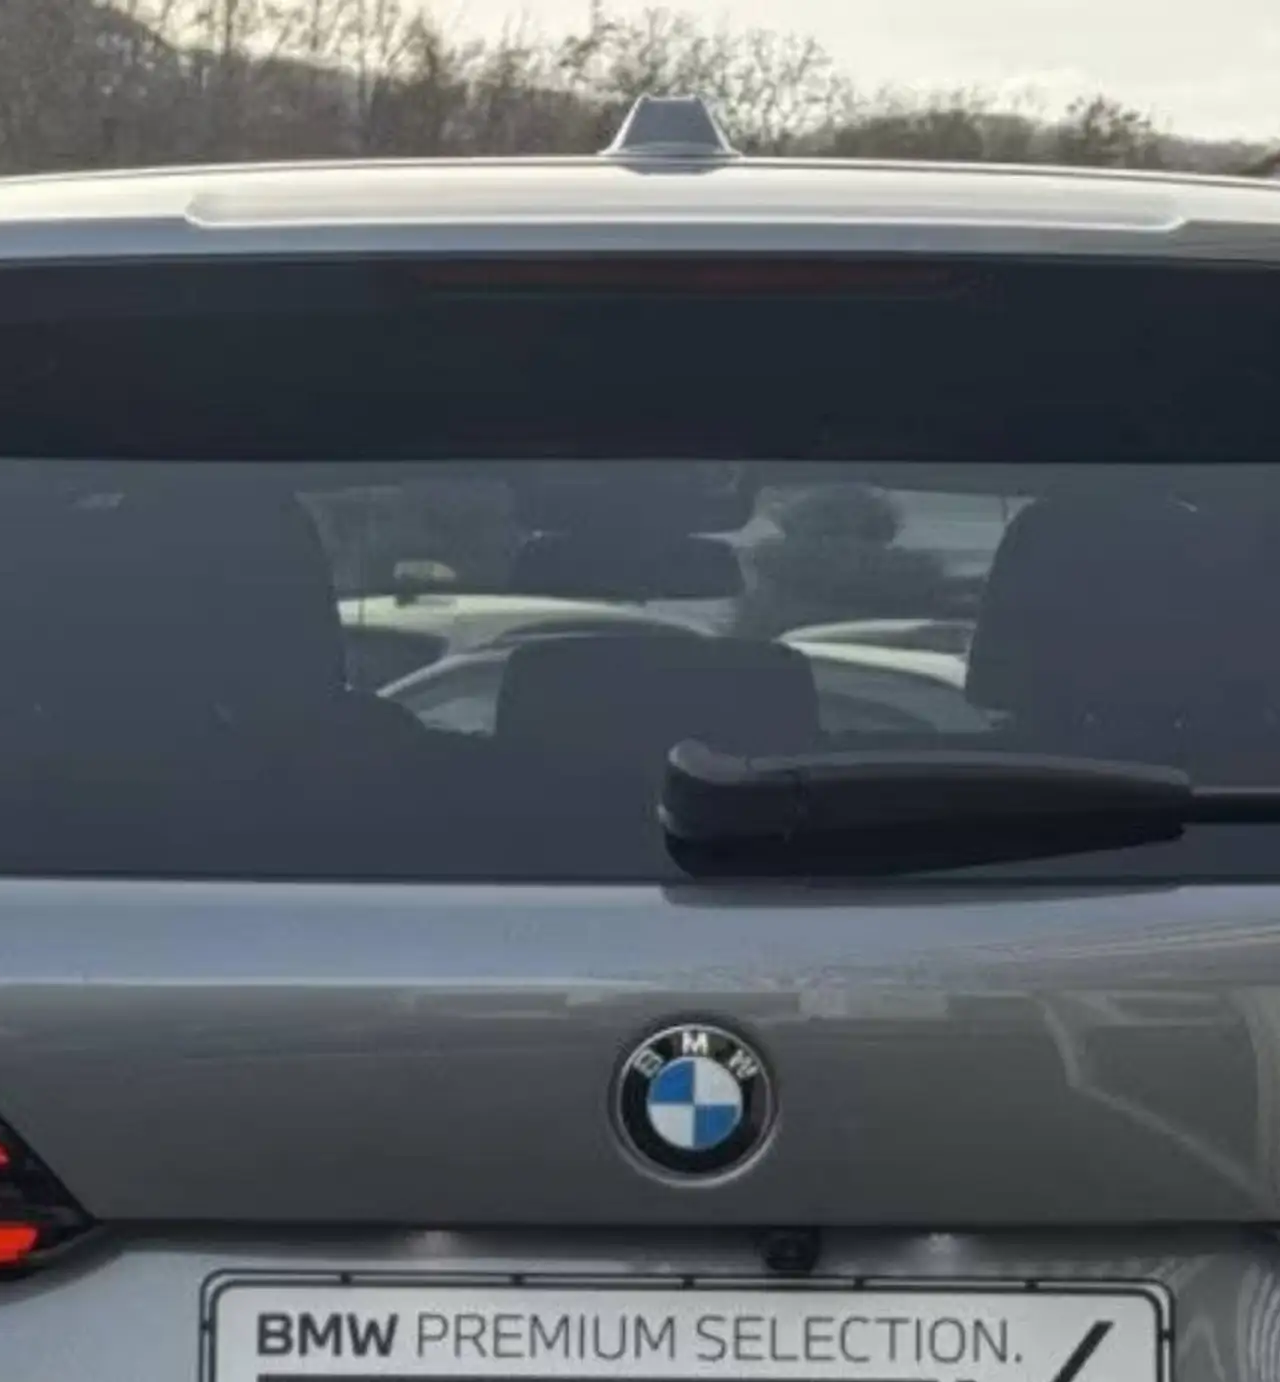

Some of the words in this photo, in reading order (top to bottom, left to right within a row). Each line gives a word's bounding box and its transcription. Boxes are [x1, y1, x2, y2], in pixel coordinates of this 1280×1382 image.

[632, 1031, 759, 1079] BMW
[256, 1312, 399, 1358] BMW
[416, 1312, 677, 1361] PREMIUM
[695, 1314, 1023, 1365] SELECTION.
